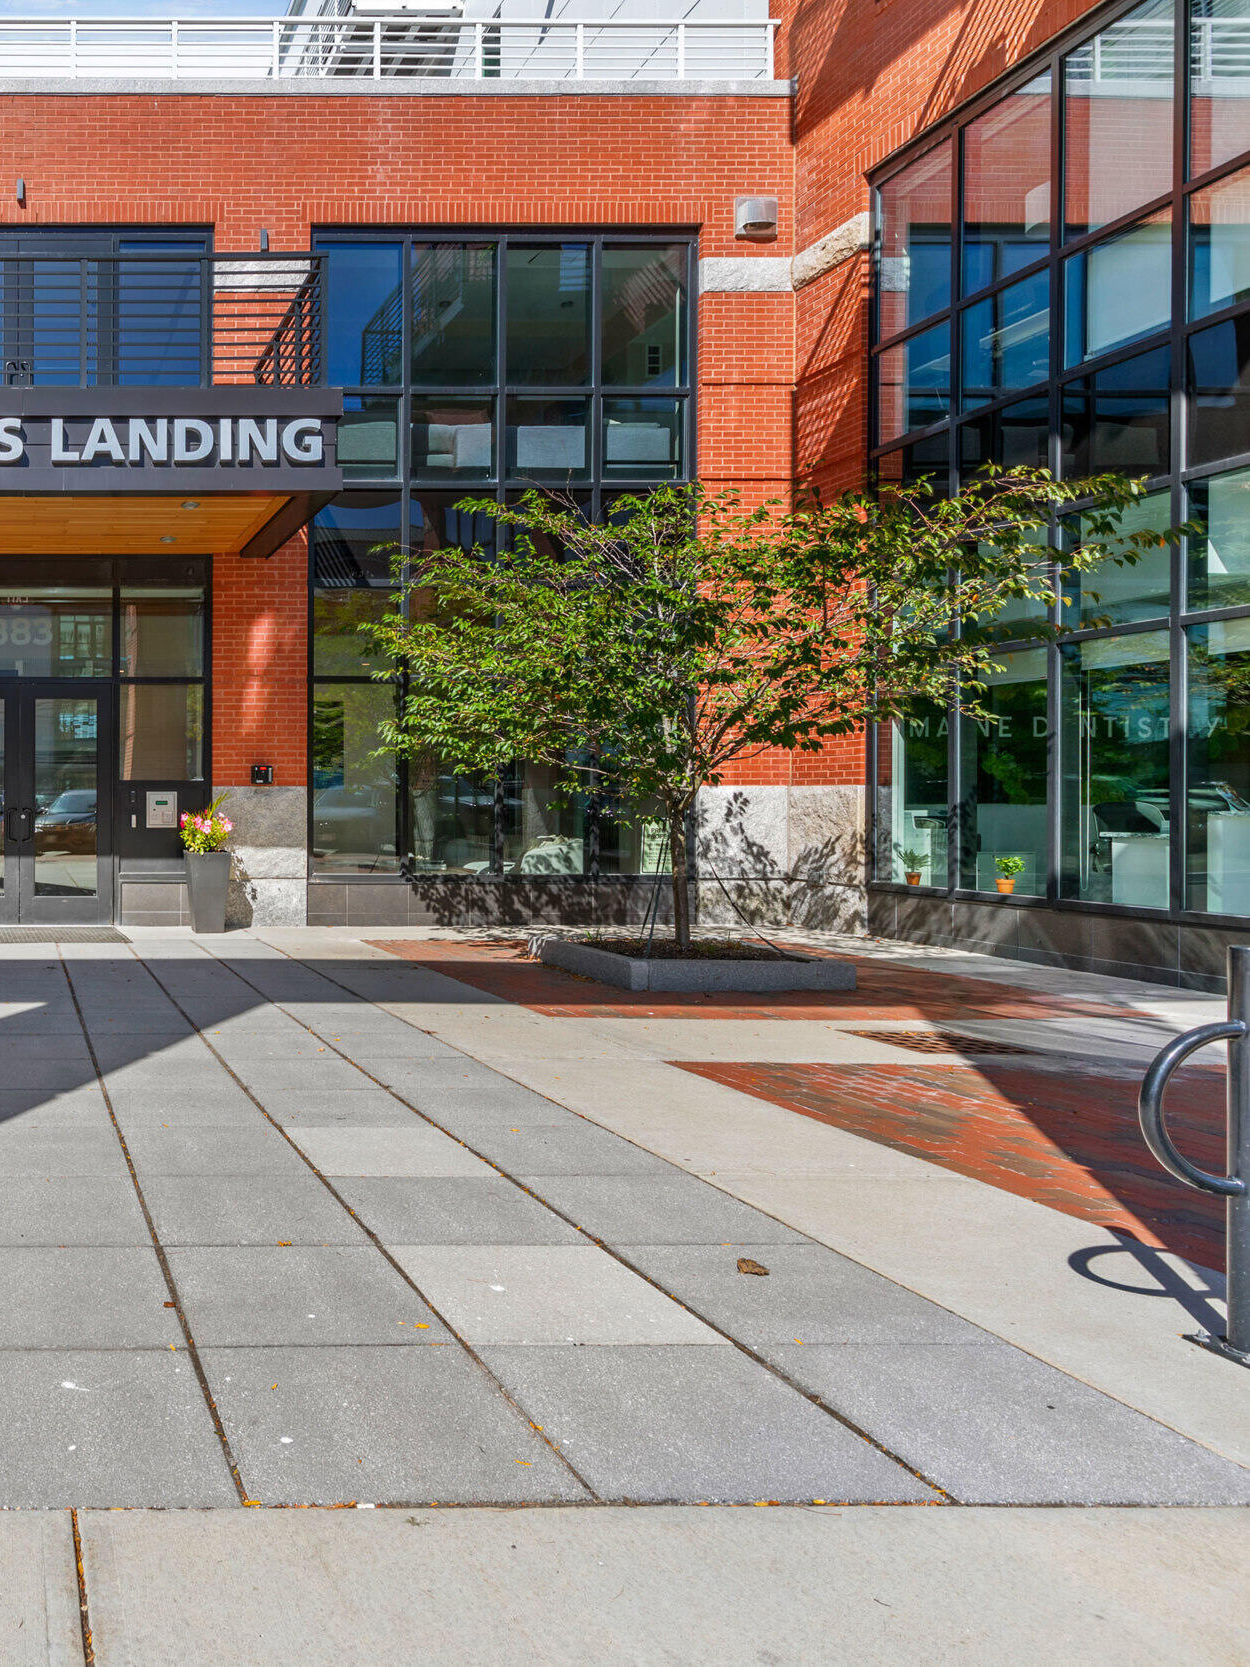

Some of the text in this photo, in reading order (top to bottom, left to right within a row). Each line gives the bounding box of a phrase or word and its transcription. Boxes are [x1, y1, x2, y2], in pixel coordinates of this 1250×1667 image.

[51, 418, 324, 464] LANDING
[910, 715, 1220, 739] MANE DNTISTY
